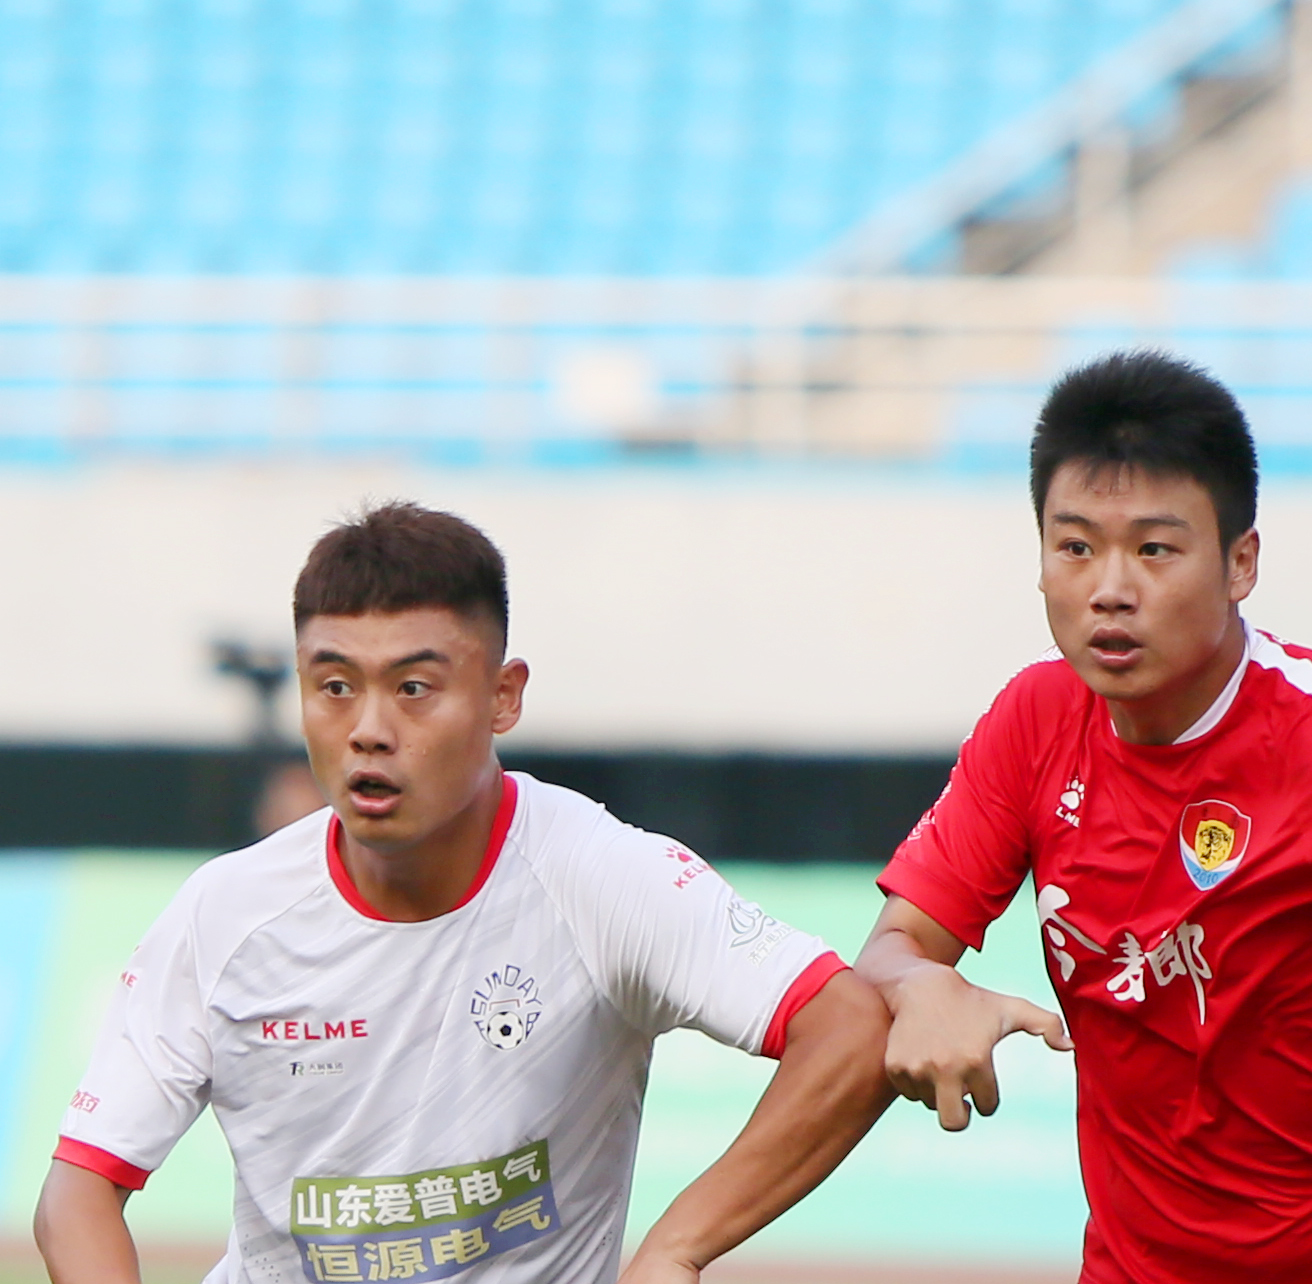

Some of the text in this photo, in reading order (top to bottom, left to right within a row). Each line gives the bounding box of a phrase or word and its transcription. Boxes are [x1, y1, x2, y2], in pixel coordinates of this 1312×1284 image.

[262, 1018, 369, 1041] KELME
[296, 1150, 542, 1229] 山东爱普电气
[307, 1195, 552, 1283] 恒源电气
